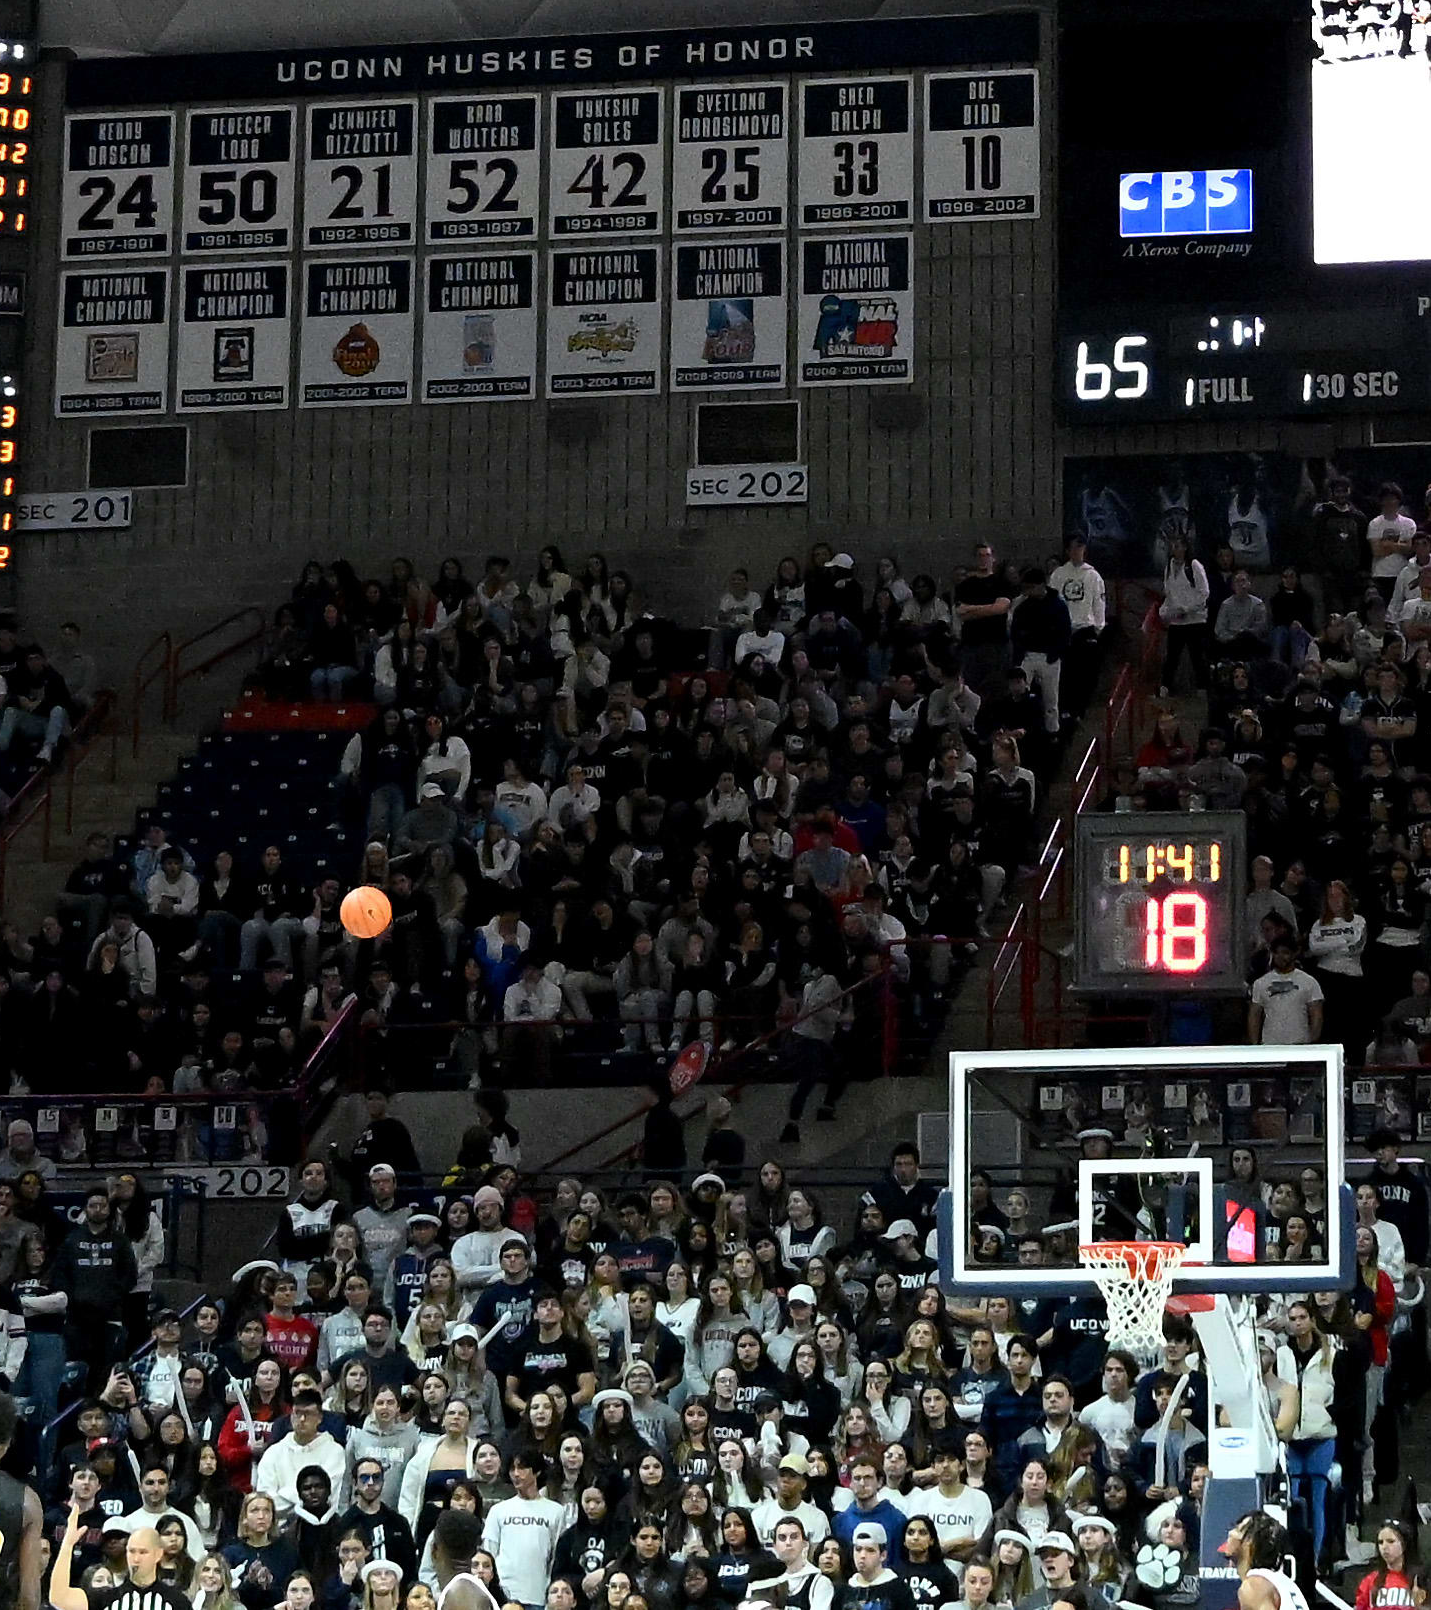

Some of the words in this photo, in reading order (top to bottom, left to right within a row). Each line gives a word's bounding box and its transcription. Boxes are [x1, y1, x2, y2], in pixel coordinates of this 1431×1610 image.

[277, 56, 403, 82] UCONN
[427, 47, 593, 75] HUSKIES
[617, 44, 661, 67] OF
[686, 36, 816, 64] HONOR
[446, 157, 519, 214] 52
[567, 151, 647, 209] 42
[701, 146, 761, 203] 25
[833, 140, 879, 197] 33
[961, 134, 1001, 191] 10
[78, 174, 158, 230] 24
[198, 170, 278, 225] 50
[328, 163, 395, 219] 21
[1120, 171, 1241, 211] CBS
[1122, 243, 1135, 257] A
[1138, 242, 1179, 257] Xerox
[1184, 239, 1253, 258] Company
[1075, 336, 1148, 401] 65
[1198, 377, 1254, 404] FULL
[1315, 374, 1345, 399] 30
[1353, 371, 1399, 396] SEC
[18, 504, 56, 520] SEC
[71, 495, 129, 523] 201
[690, 479, 728, 495] SEC
[737, 471, 805, 497] 202
[1120, 844, 1221, 883] 11:41
[1145, 891, 1208, 973] 18
[217, 1168, 286, 1196] 202
[503, 1516, 550, 1528] UCONN
